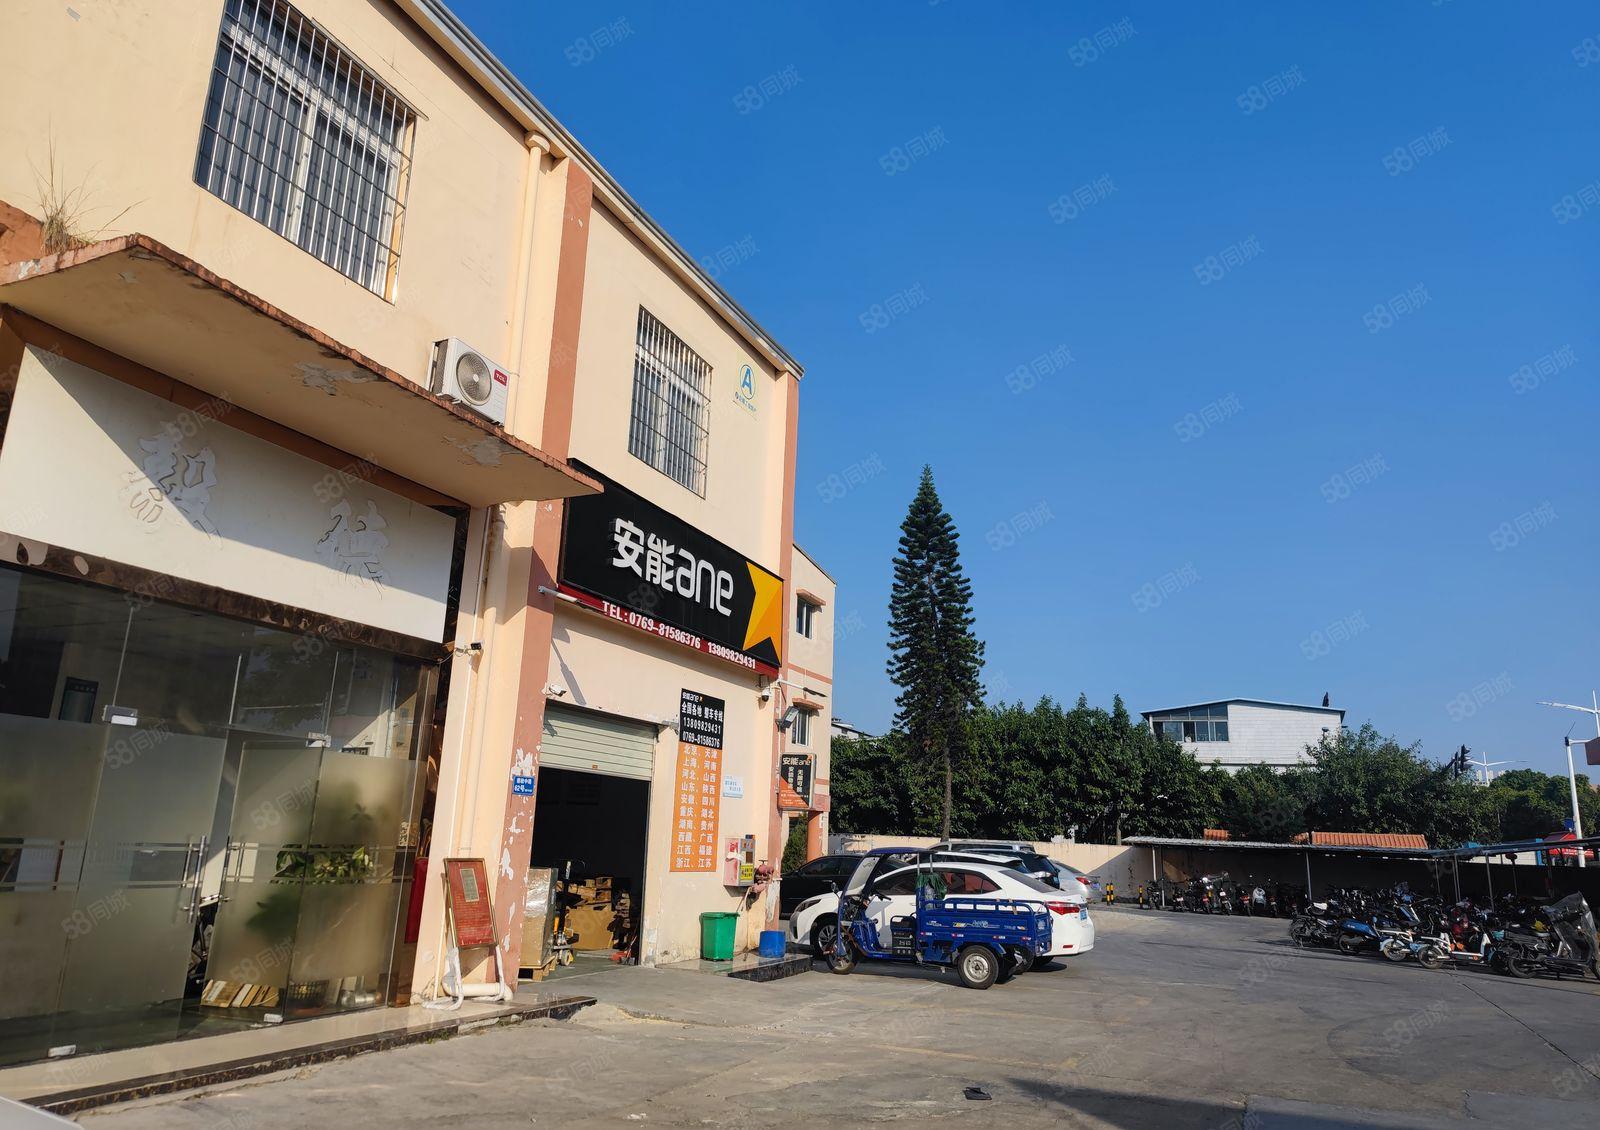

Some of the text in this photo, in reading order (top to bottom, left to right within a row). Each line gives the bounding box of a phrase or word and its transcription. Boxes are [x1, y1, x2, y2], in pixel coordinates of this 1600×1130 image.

[612, 517, 734, 617] 安能ane
[707, 641, 756, 669] 13809829431
[683, 716, 721, 734] 13809829431
[682, 730, 720, 748] 0769-81586376
